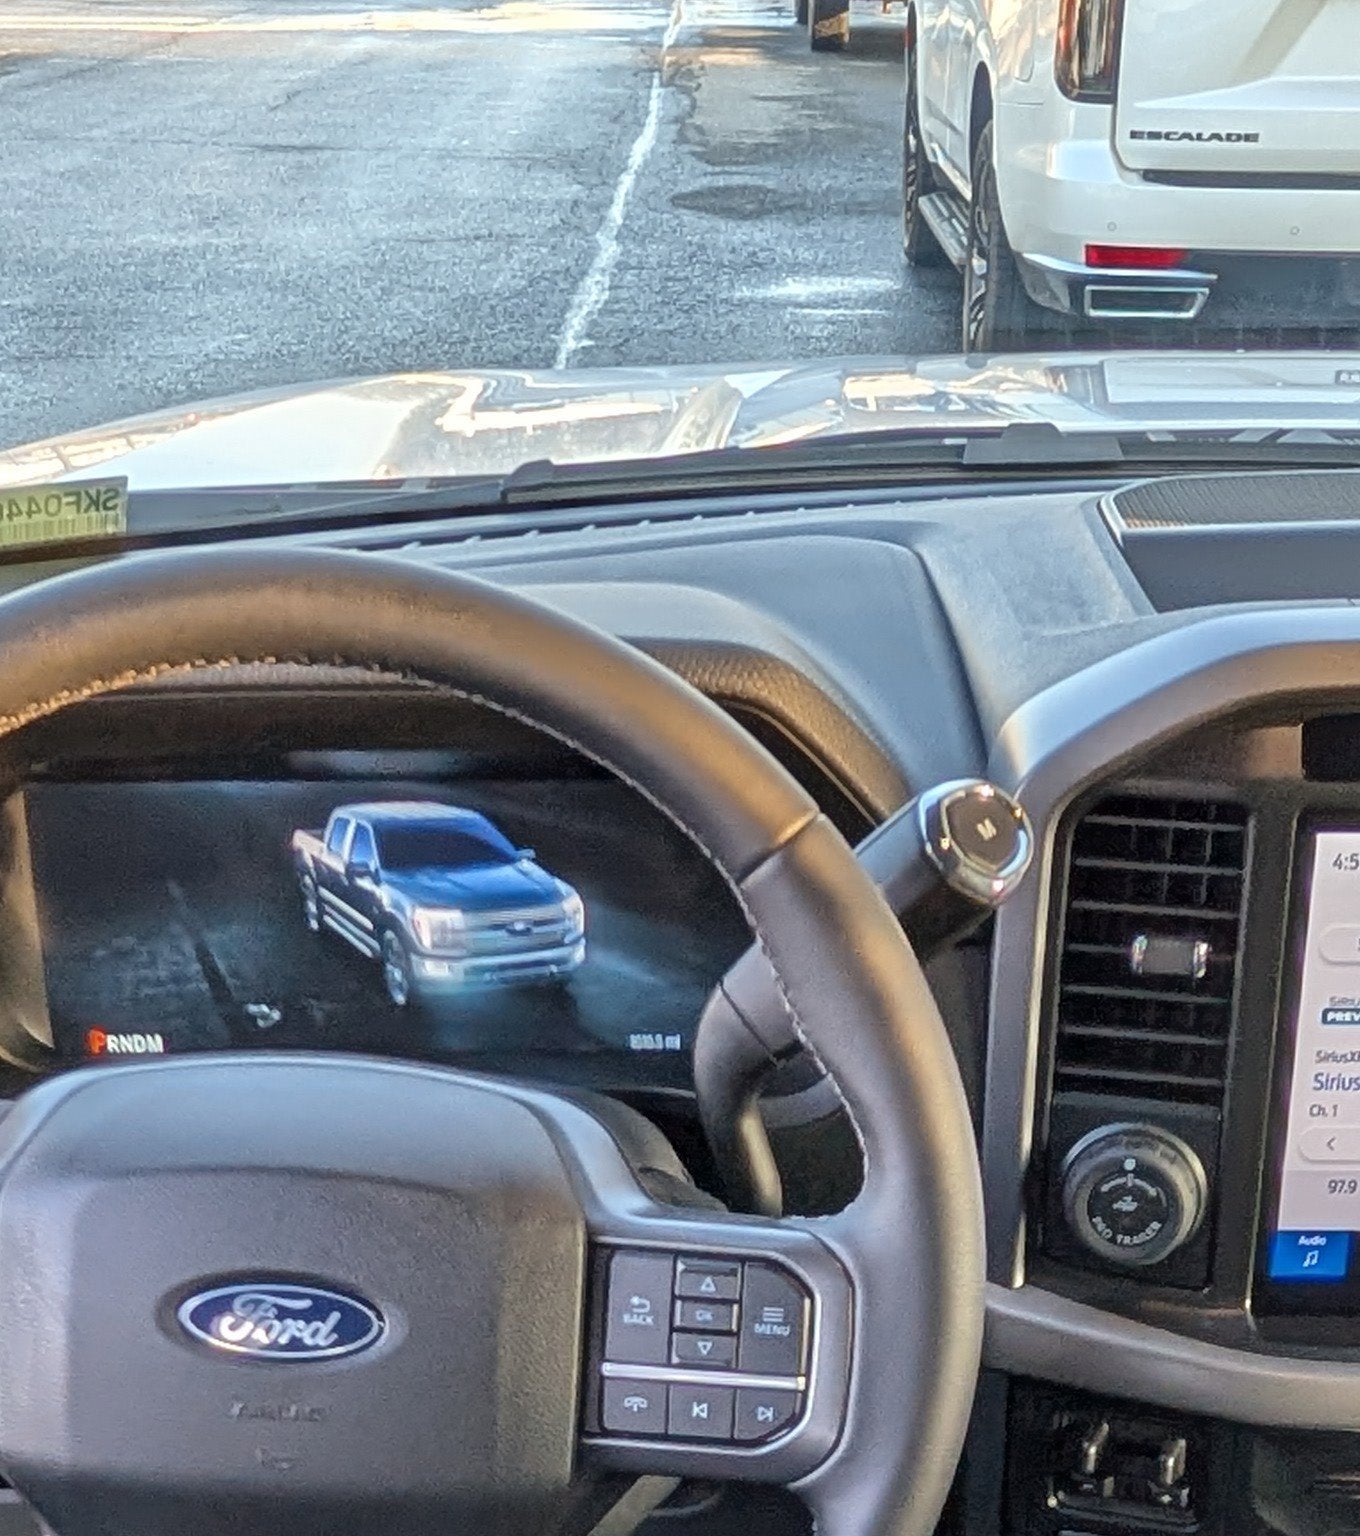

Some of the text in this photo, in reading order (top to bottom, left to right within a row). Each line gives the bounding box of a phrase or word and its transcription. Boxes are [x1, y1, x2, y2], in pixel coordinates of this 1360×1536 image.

[1129, 130, 1260, 143] ESCALADE
[1331, 1104, 1338, 1117] 1
[1327, 1180, 1358, 1194] 97.9
[1298, 1235, 1326, 1246] Audio
[218, 1292, 342, 1347] Ford
[622, 1314, 654, 1326] BACK
[695, 1310, 713, 1322] OK
[754, 1324, 791, 1338] MENU
